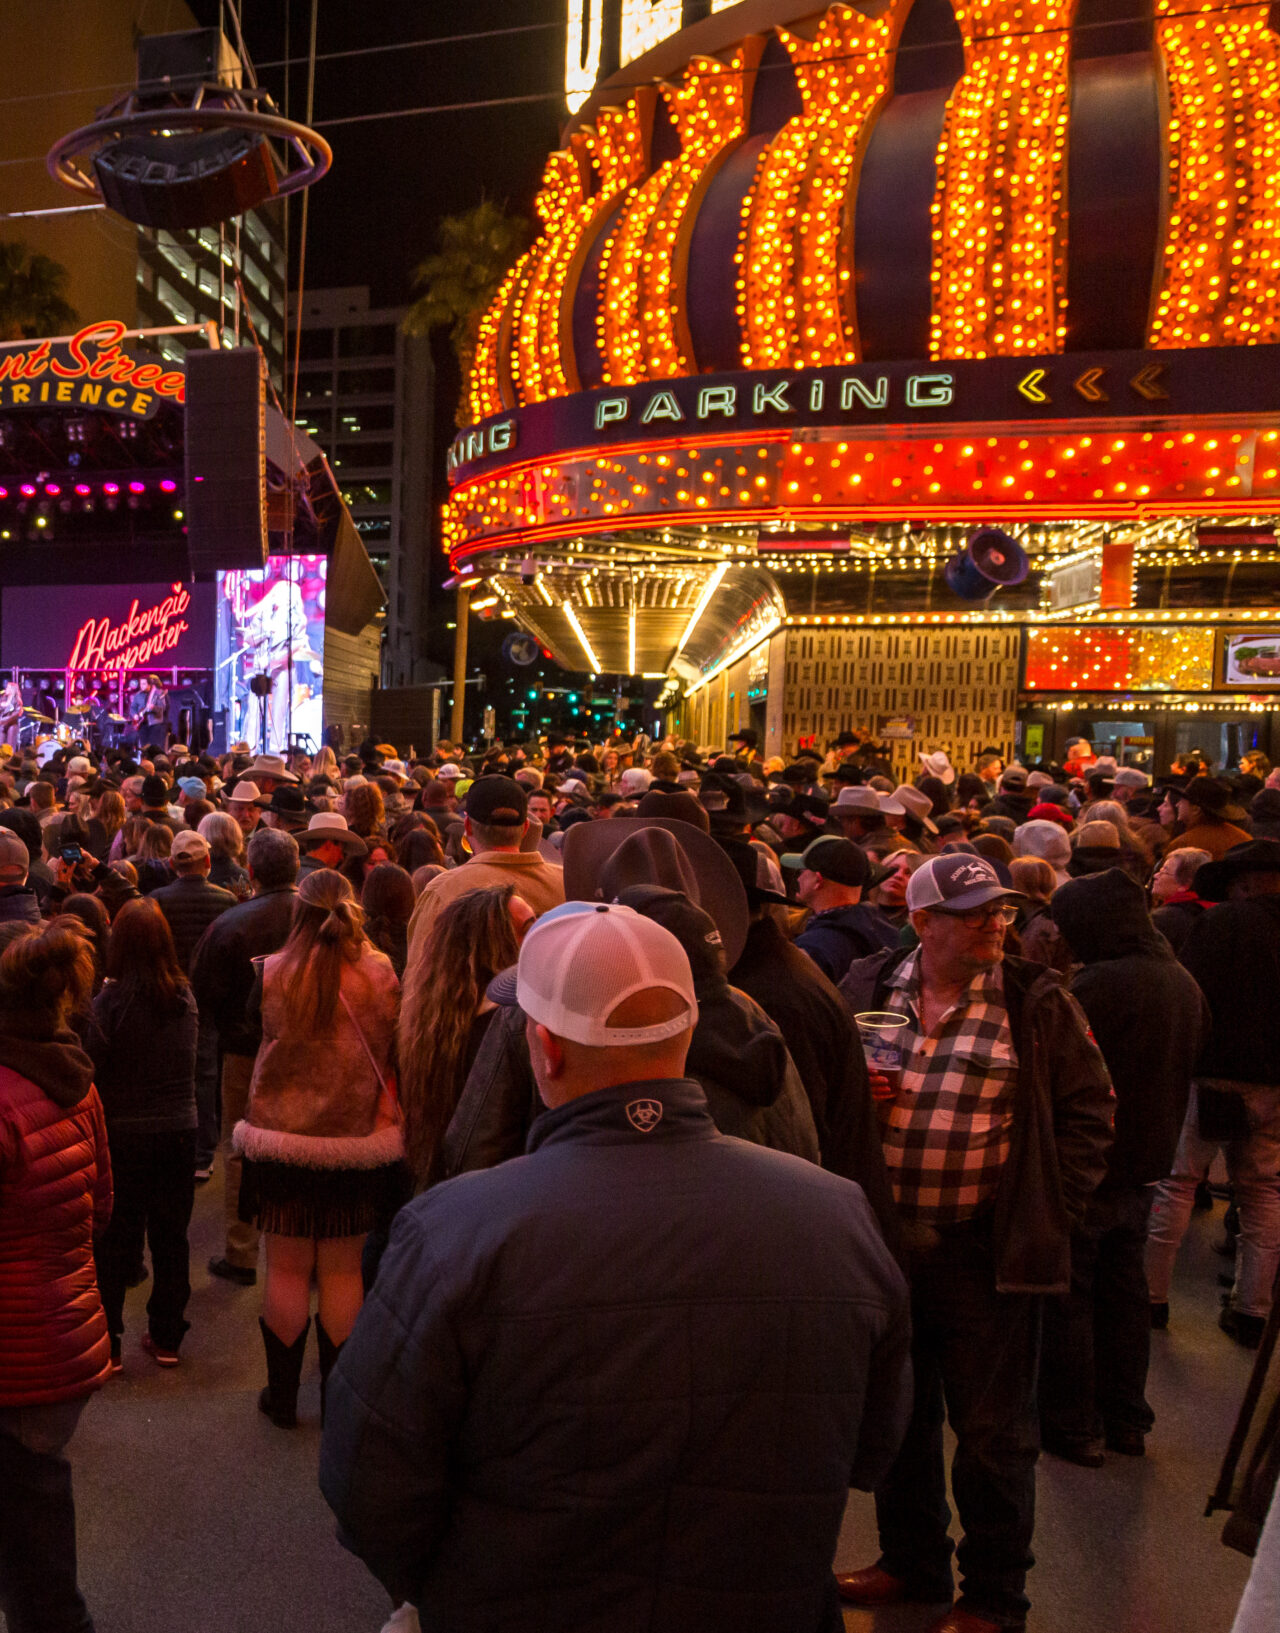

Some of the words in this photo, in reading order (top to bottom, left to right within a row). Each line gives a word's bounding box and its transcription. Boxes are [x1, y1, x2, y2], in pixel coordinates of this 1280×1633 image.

[50, 320, 185, 403] Stree
[595, 374, 954, 430] PARKING
[69, 582, 190, 676] Mackenzie
